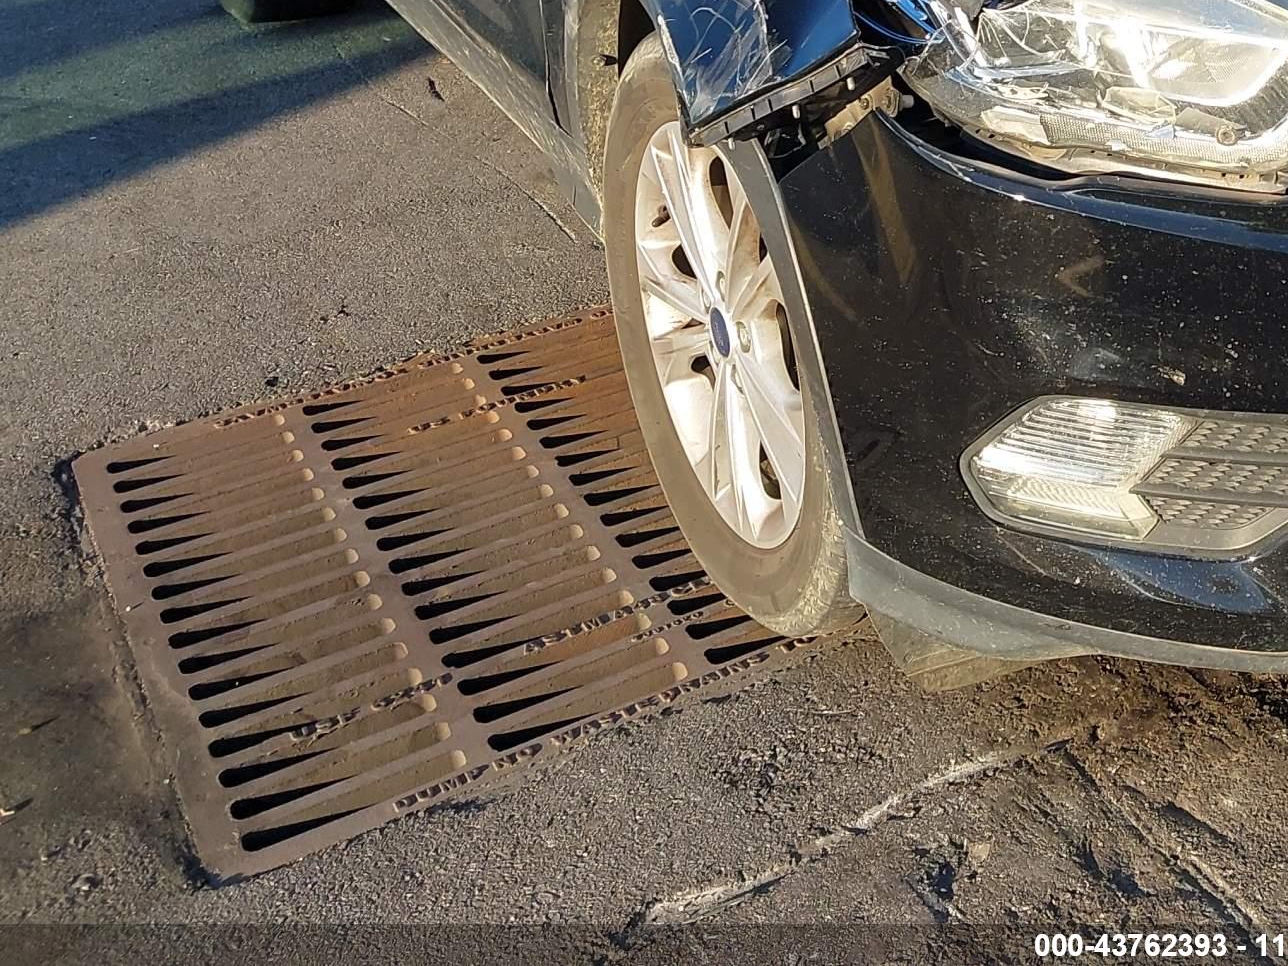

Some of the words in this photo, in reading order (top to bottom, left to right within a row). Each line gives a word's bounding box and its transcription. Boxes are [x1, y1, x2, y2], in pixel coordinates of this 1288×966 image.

[523, 612, 611, 656] ASTM
[288, 707, 361, 743] USF
[392, 763, 490, 813] DUMP
[491, 742, 544, 772] NO
[551, 695, 660, 746] WASTE
[659, 652, 771, 704] DRAINS
